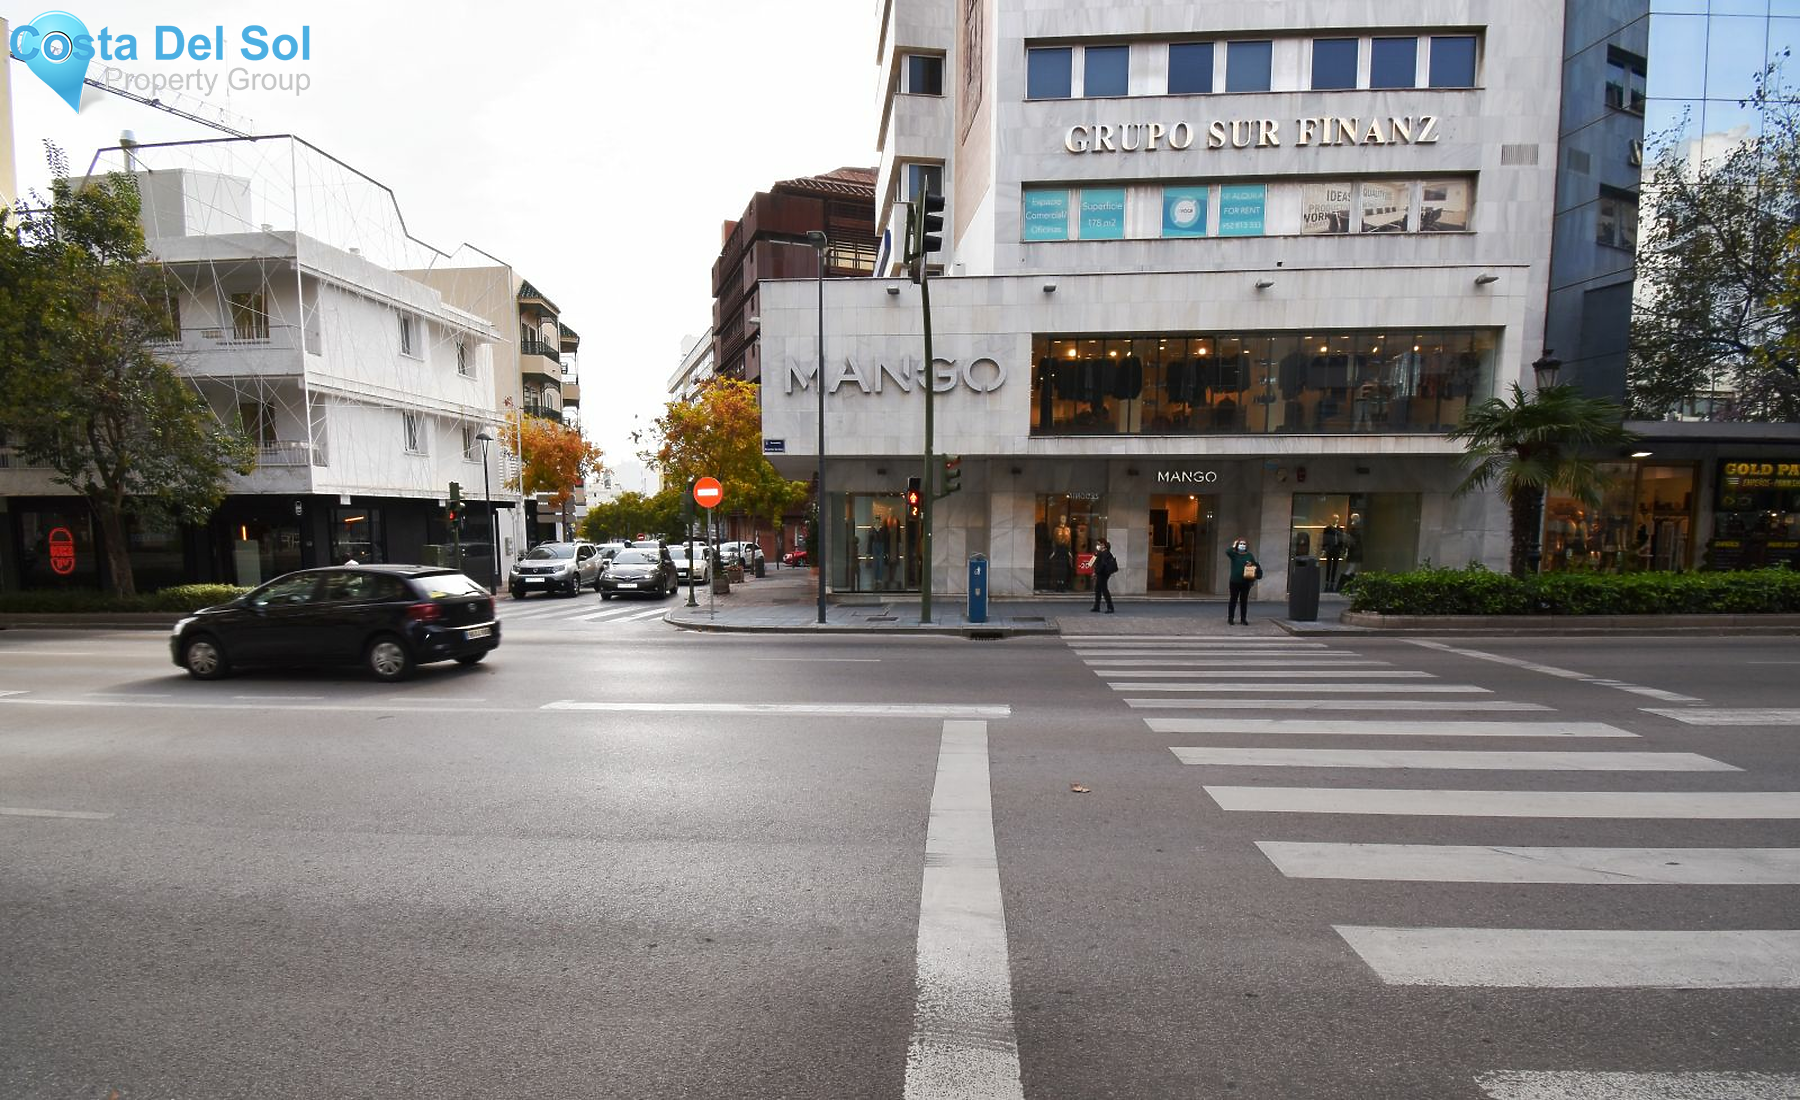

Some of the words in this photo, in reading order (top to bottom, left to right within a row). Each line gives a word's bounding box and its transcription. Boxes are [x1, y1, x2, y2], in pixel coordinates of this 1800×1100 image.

[1064, 122, 1194, 153] GRUPO
[1208, 119, 1280, 148] SUR
[1295, 115, 1440, 147] FINANZ
[1082, 201, 1123, 212] Superficie
[1223, 207, 1239, 215] FOR
[1241, 206, 1261, 215] RENT
[784, 355, 1008, 395] MANGO
[1157, 470, 1217, 483] MANGO
[1726, 463, 1773, 475] GOLD
[1777, 464, 1800, 477] PA
